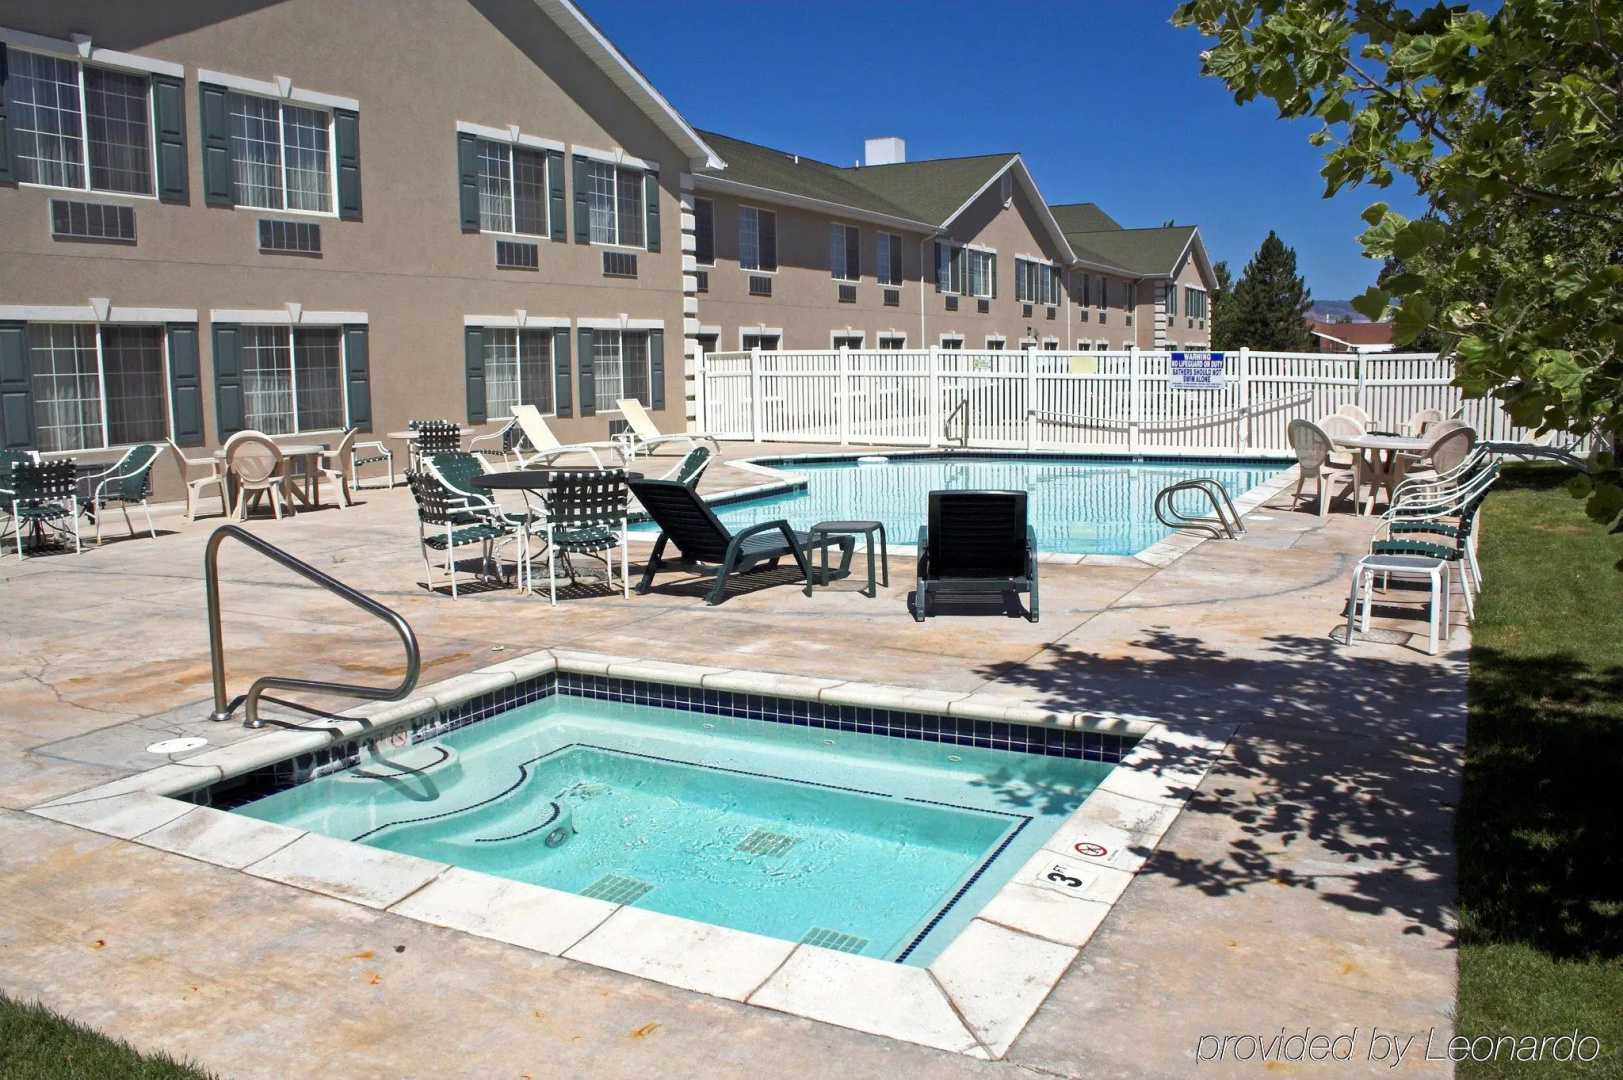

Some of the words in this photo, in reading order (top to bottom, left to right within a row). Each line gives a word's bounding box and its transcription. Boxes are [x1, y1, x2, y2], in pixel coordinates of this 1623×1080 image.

[1184, 353, 1211, 361] WARNING
[1053, 864, 1067, 873] FT
[1047, 872, 1082, 887] 3
